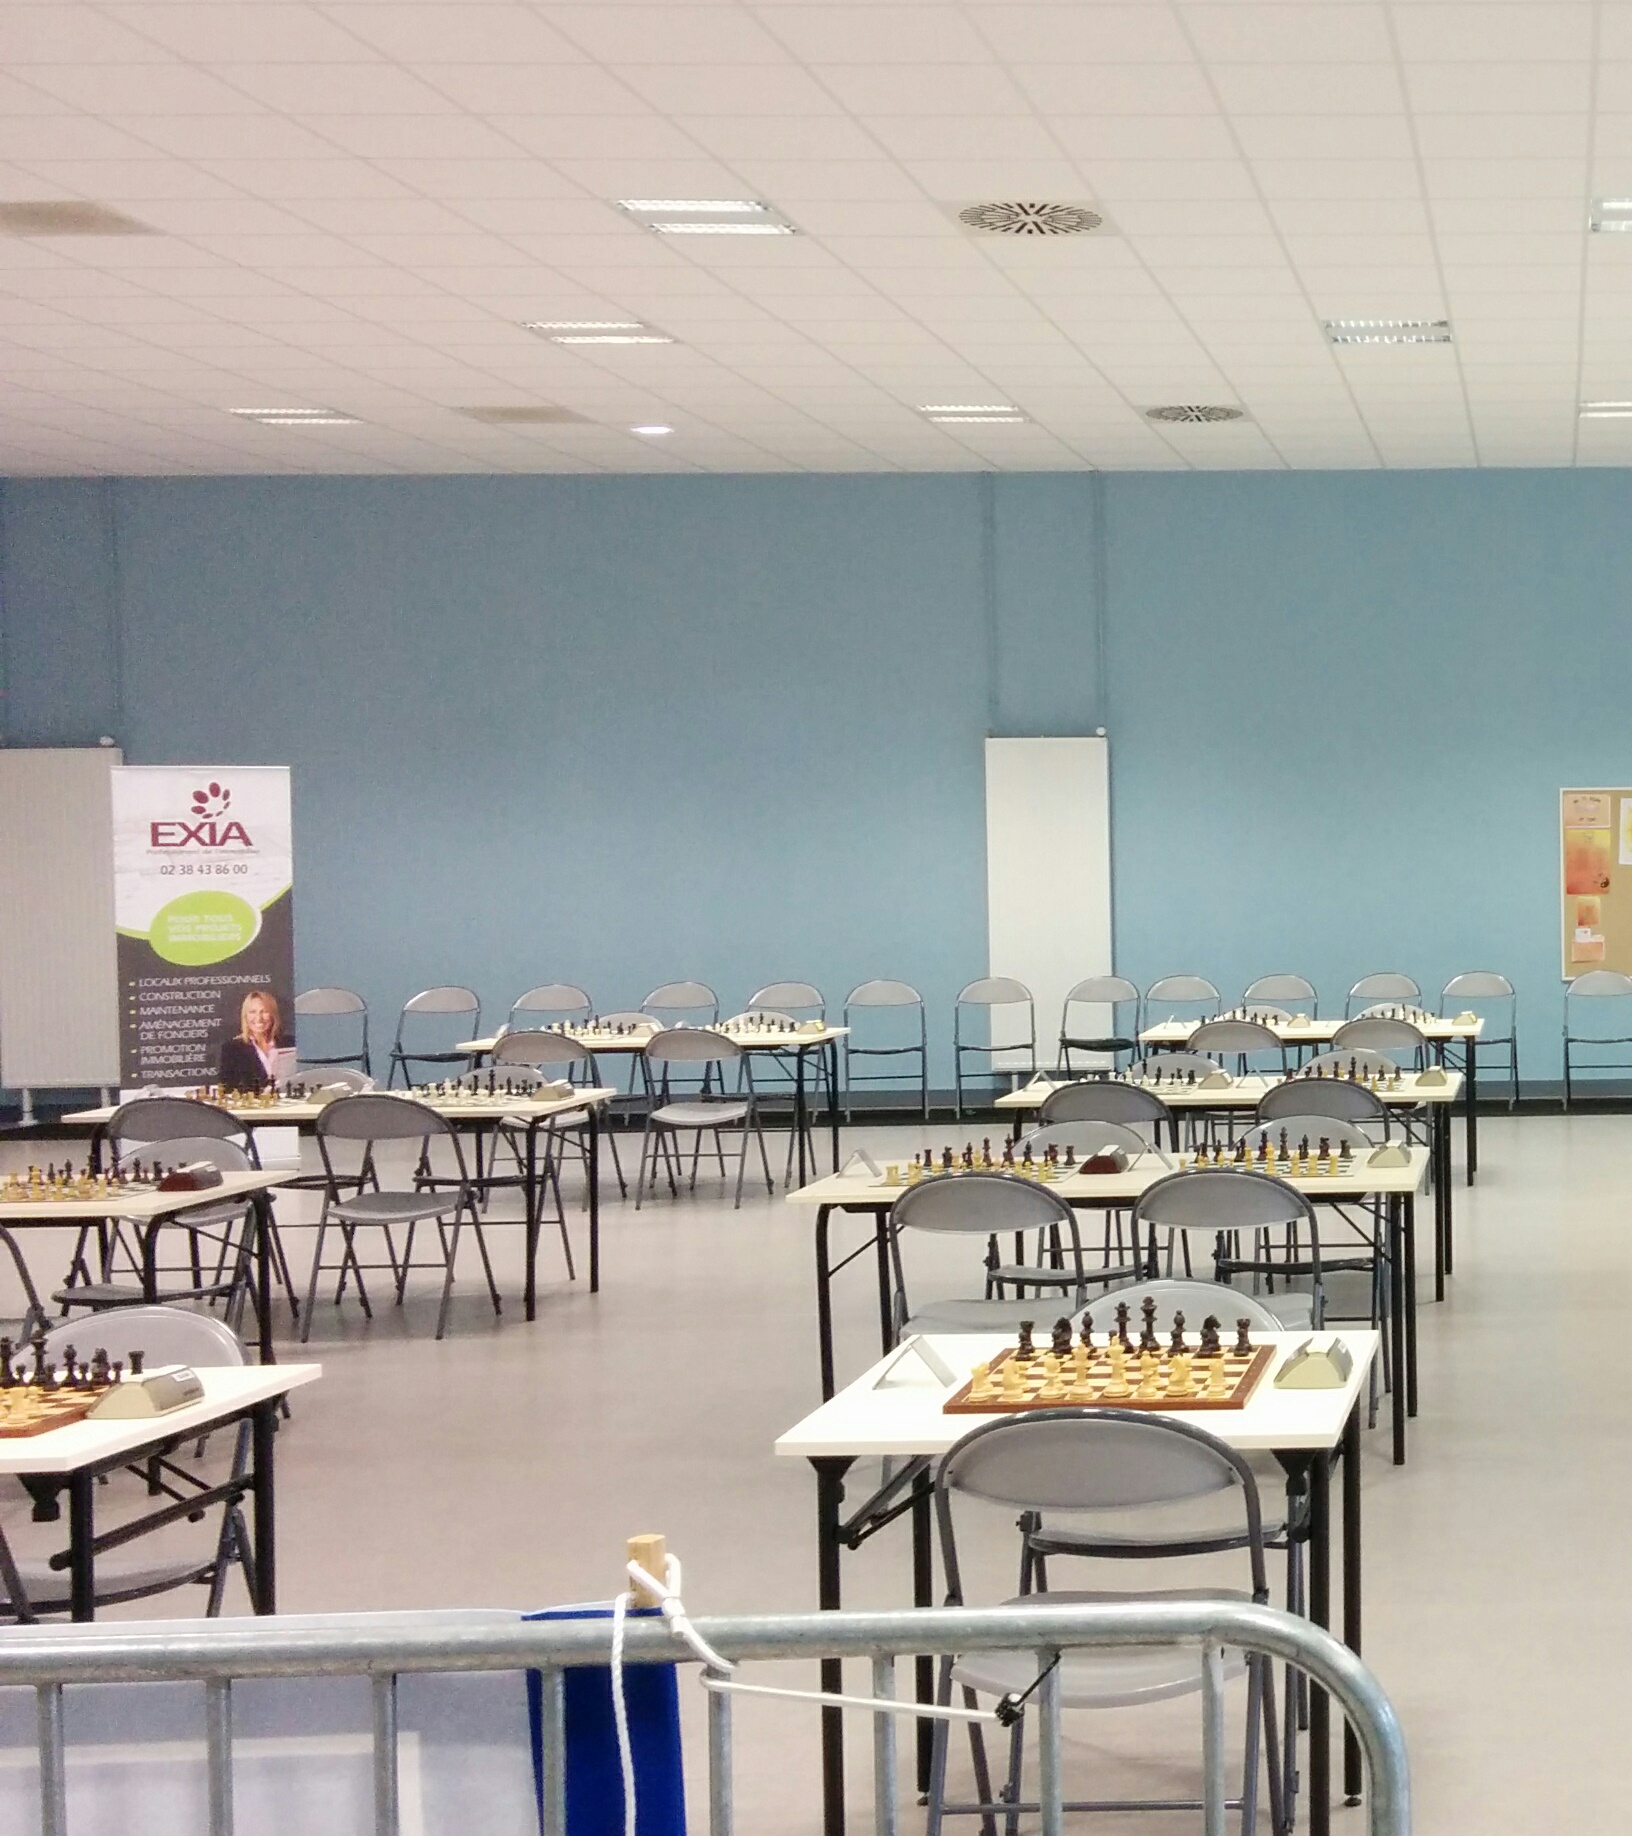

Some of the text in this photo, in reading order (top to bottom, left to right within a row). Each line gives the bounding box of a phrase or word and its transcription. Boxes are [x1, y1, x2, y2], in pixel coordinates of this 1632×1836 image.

[150, 821, 254, 848] EXIA
[160, 864, 249, 876] 02 38 43 86 00
[138, 974, 272, 988] LOCAUX PROFESSIONNELS
[138, 990, 222, 1002] CONSTRUCTION
[139, 1003, 216, 1016] MAINTENANCE
[138, 1018, 222, 1030] AMÉNAGEMENT
[140, 1029, 209, 1041] DE FONCIERS
[140, 1043, 207, 1055] PROMOTION
[140, 1053, 207, 1066] IMMOBILIÈRE
[141, 1067, 218, 1079] TRANSACTIONS
